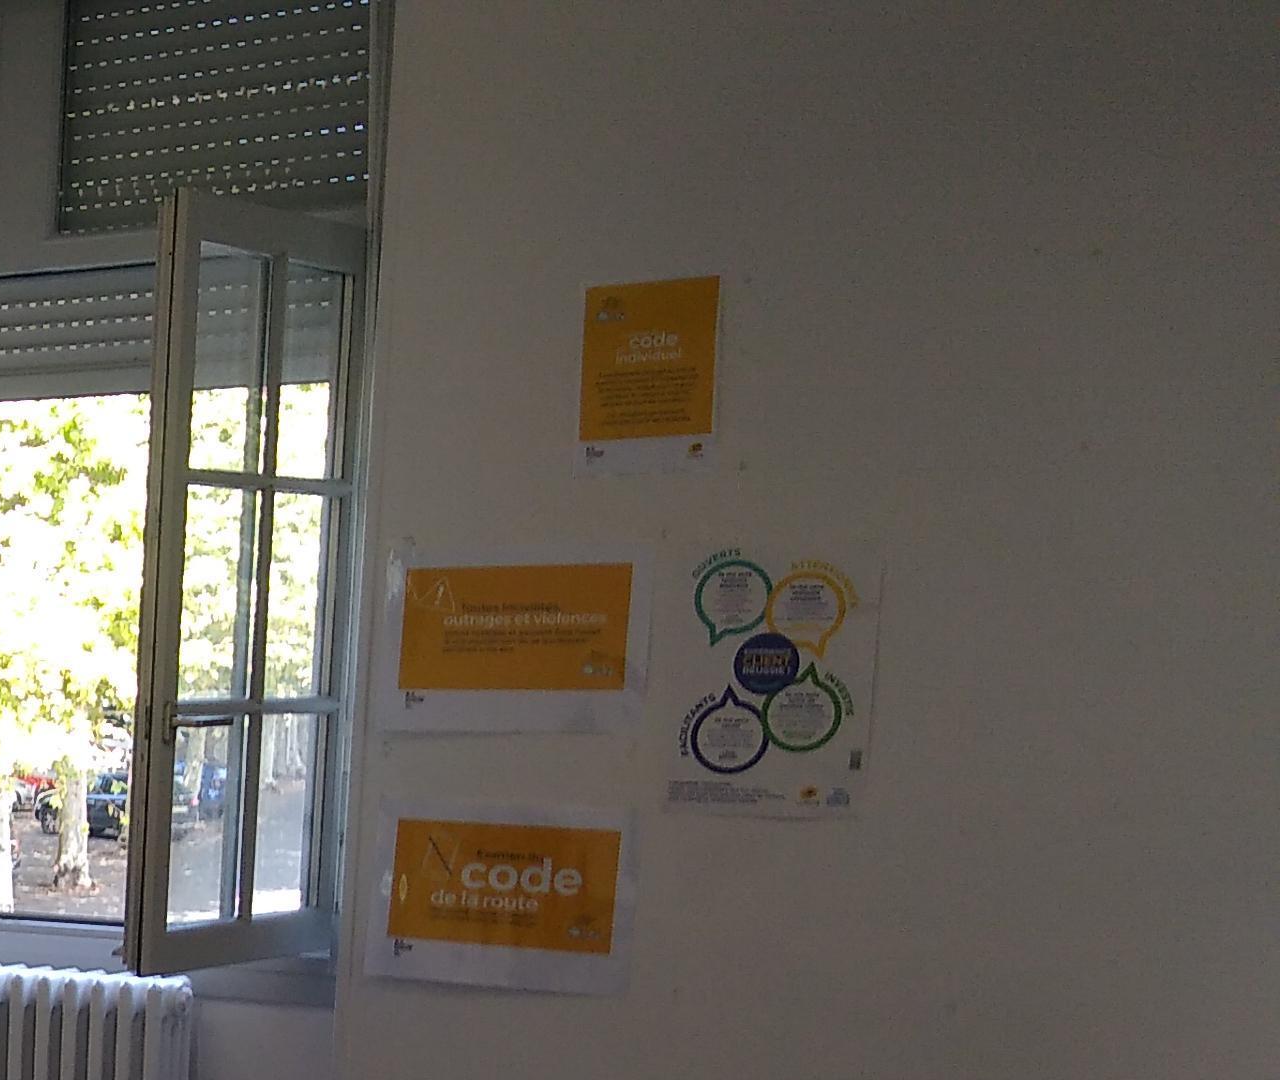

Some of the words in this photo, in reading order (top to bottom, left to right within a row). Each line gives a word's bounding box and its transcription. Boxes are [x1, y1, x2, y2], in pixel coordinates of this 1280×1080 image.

[628, 331, 679, 349] code
[615, 348, 682, 365] individuel
[443, 613, 512, 629] outrages
[514, 613, 531, 625] et
[532, 611, 608, 625] violences
[460, 857, 584, 896] code
[430, 889, 457, 906] de
[460, 889, 481, 908] la
[482, 893, 540, 912] route
